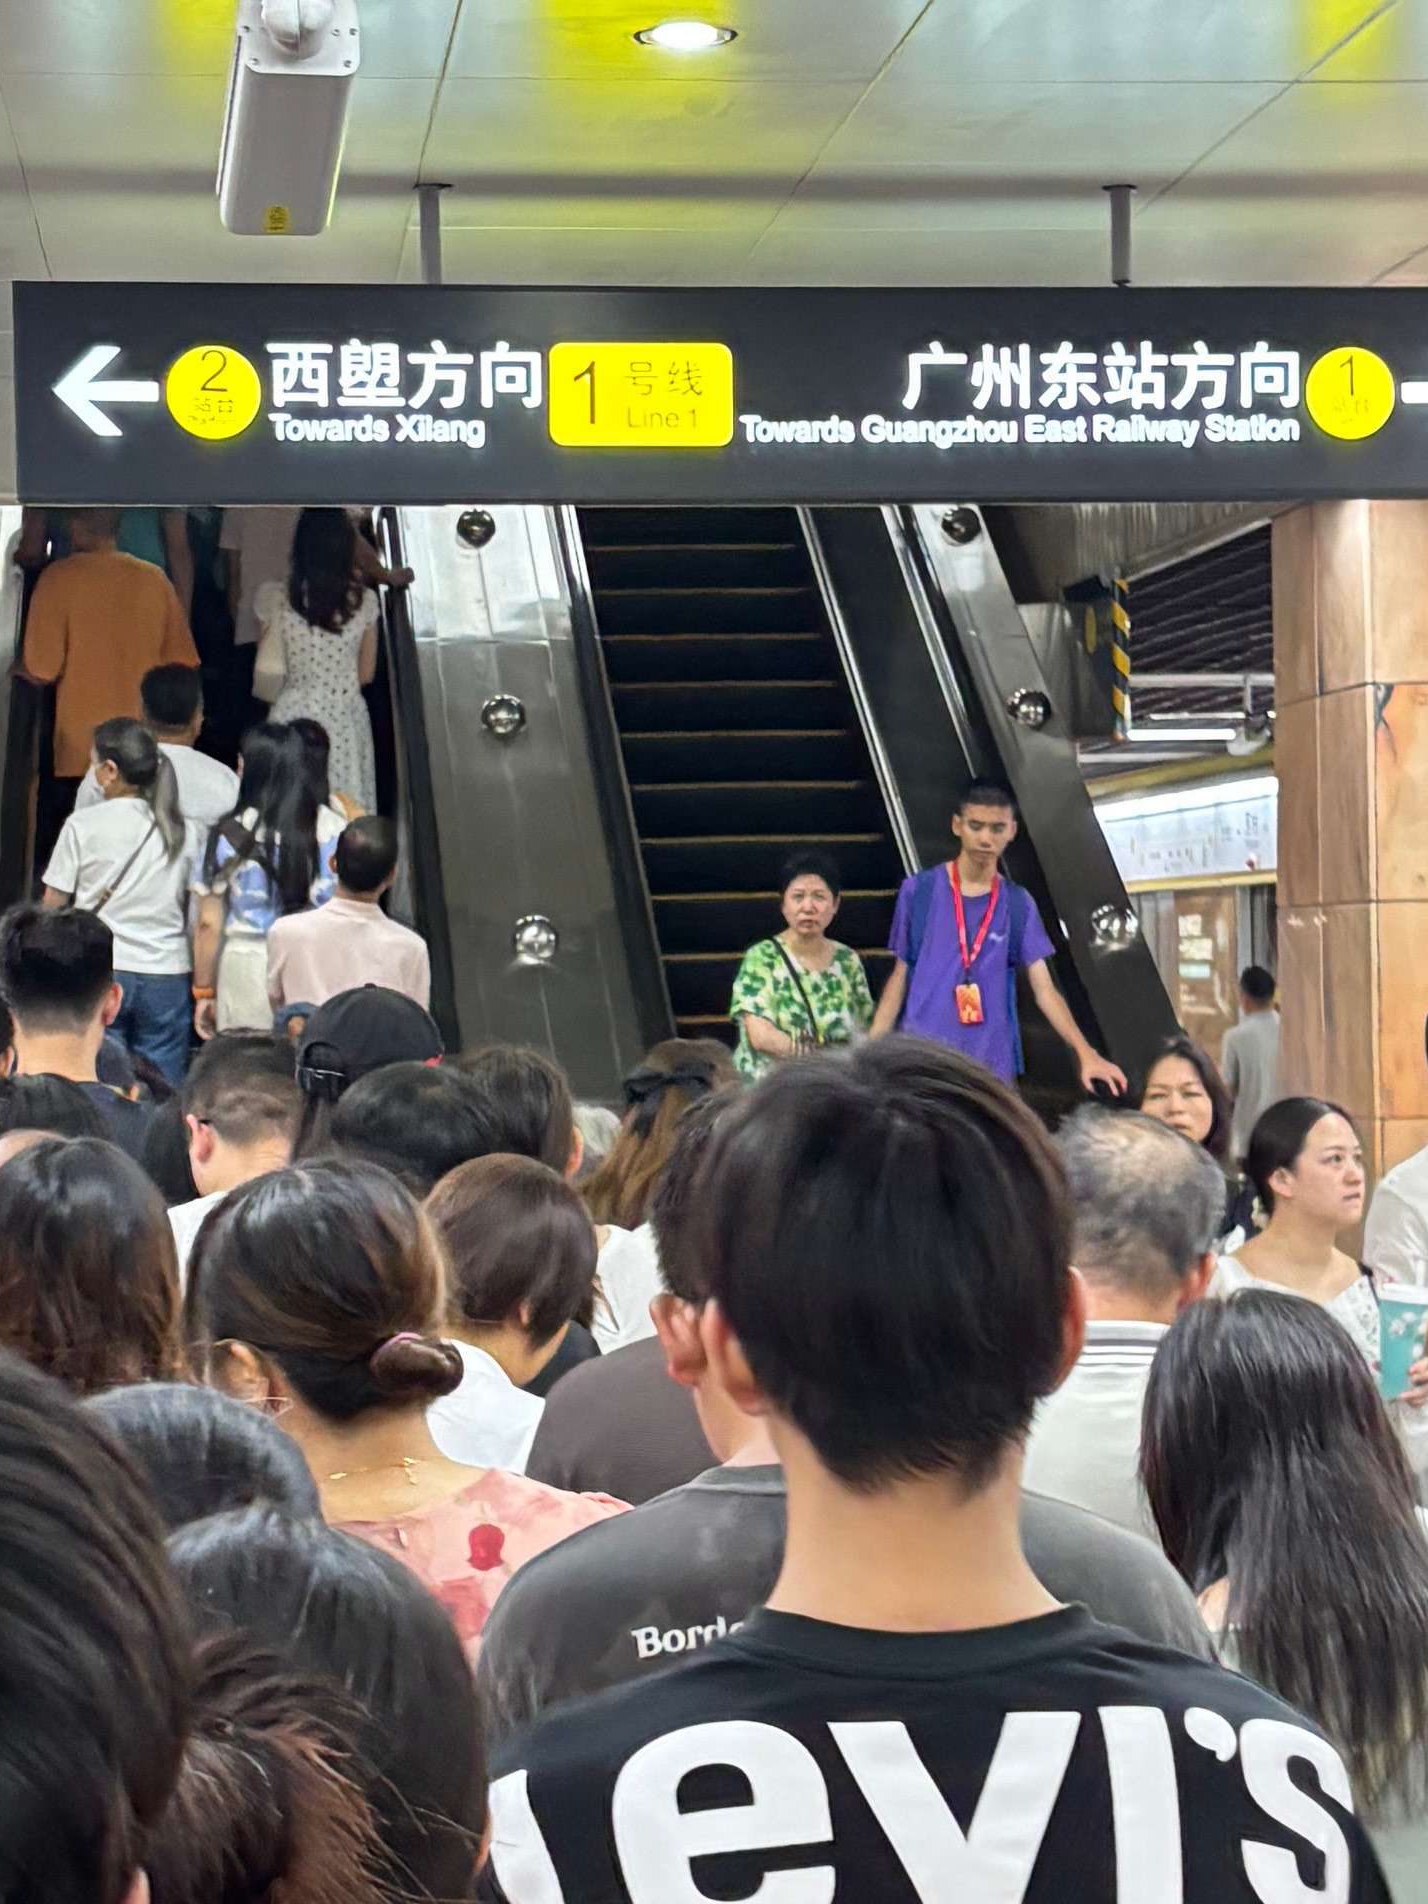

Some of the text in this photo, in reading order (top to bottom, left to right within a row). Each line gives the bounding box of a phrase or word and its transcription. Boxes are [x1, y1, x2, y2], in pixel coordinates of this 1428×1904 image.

[200, 349, 228, 392] 2
[266, 338, 542, 409] 西塱方向
[901, 340, 1301, 411] 广州东站方向
[1339, 355, 1354, 396] 1
[573, 360, 703, 425] 1 号线
[268, 413, 487, 448] Towards Xilang
[627, 406, 697, 428] Line 1
[739, 413, 1301, 449] Towards Guangzhou East Railway Station
